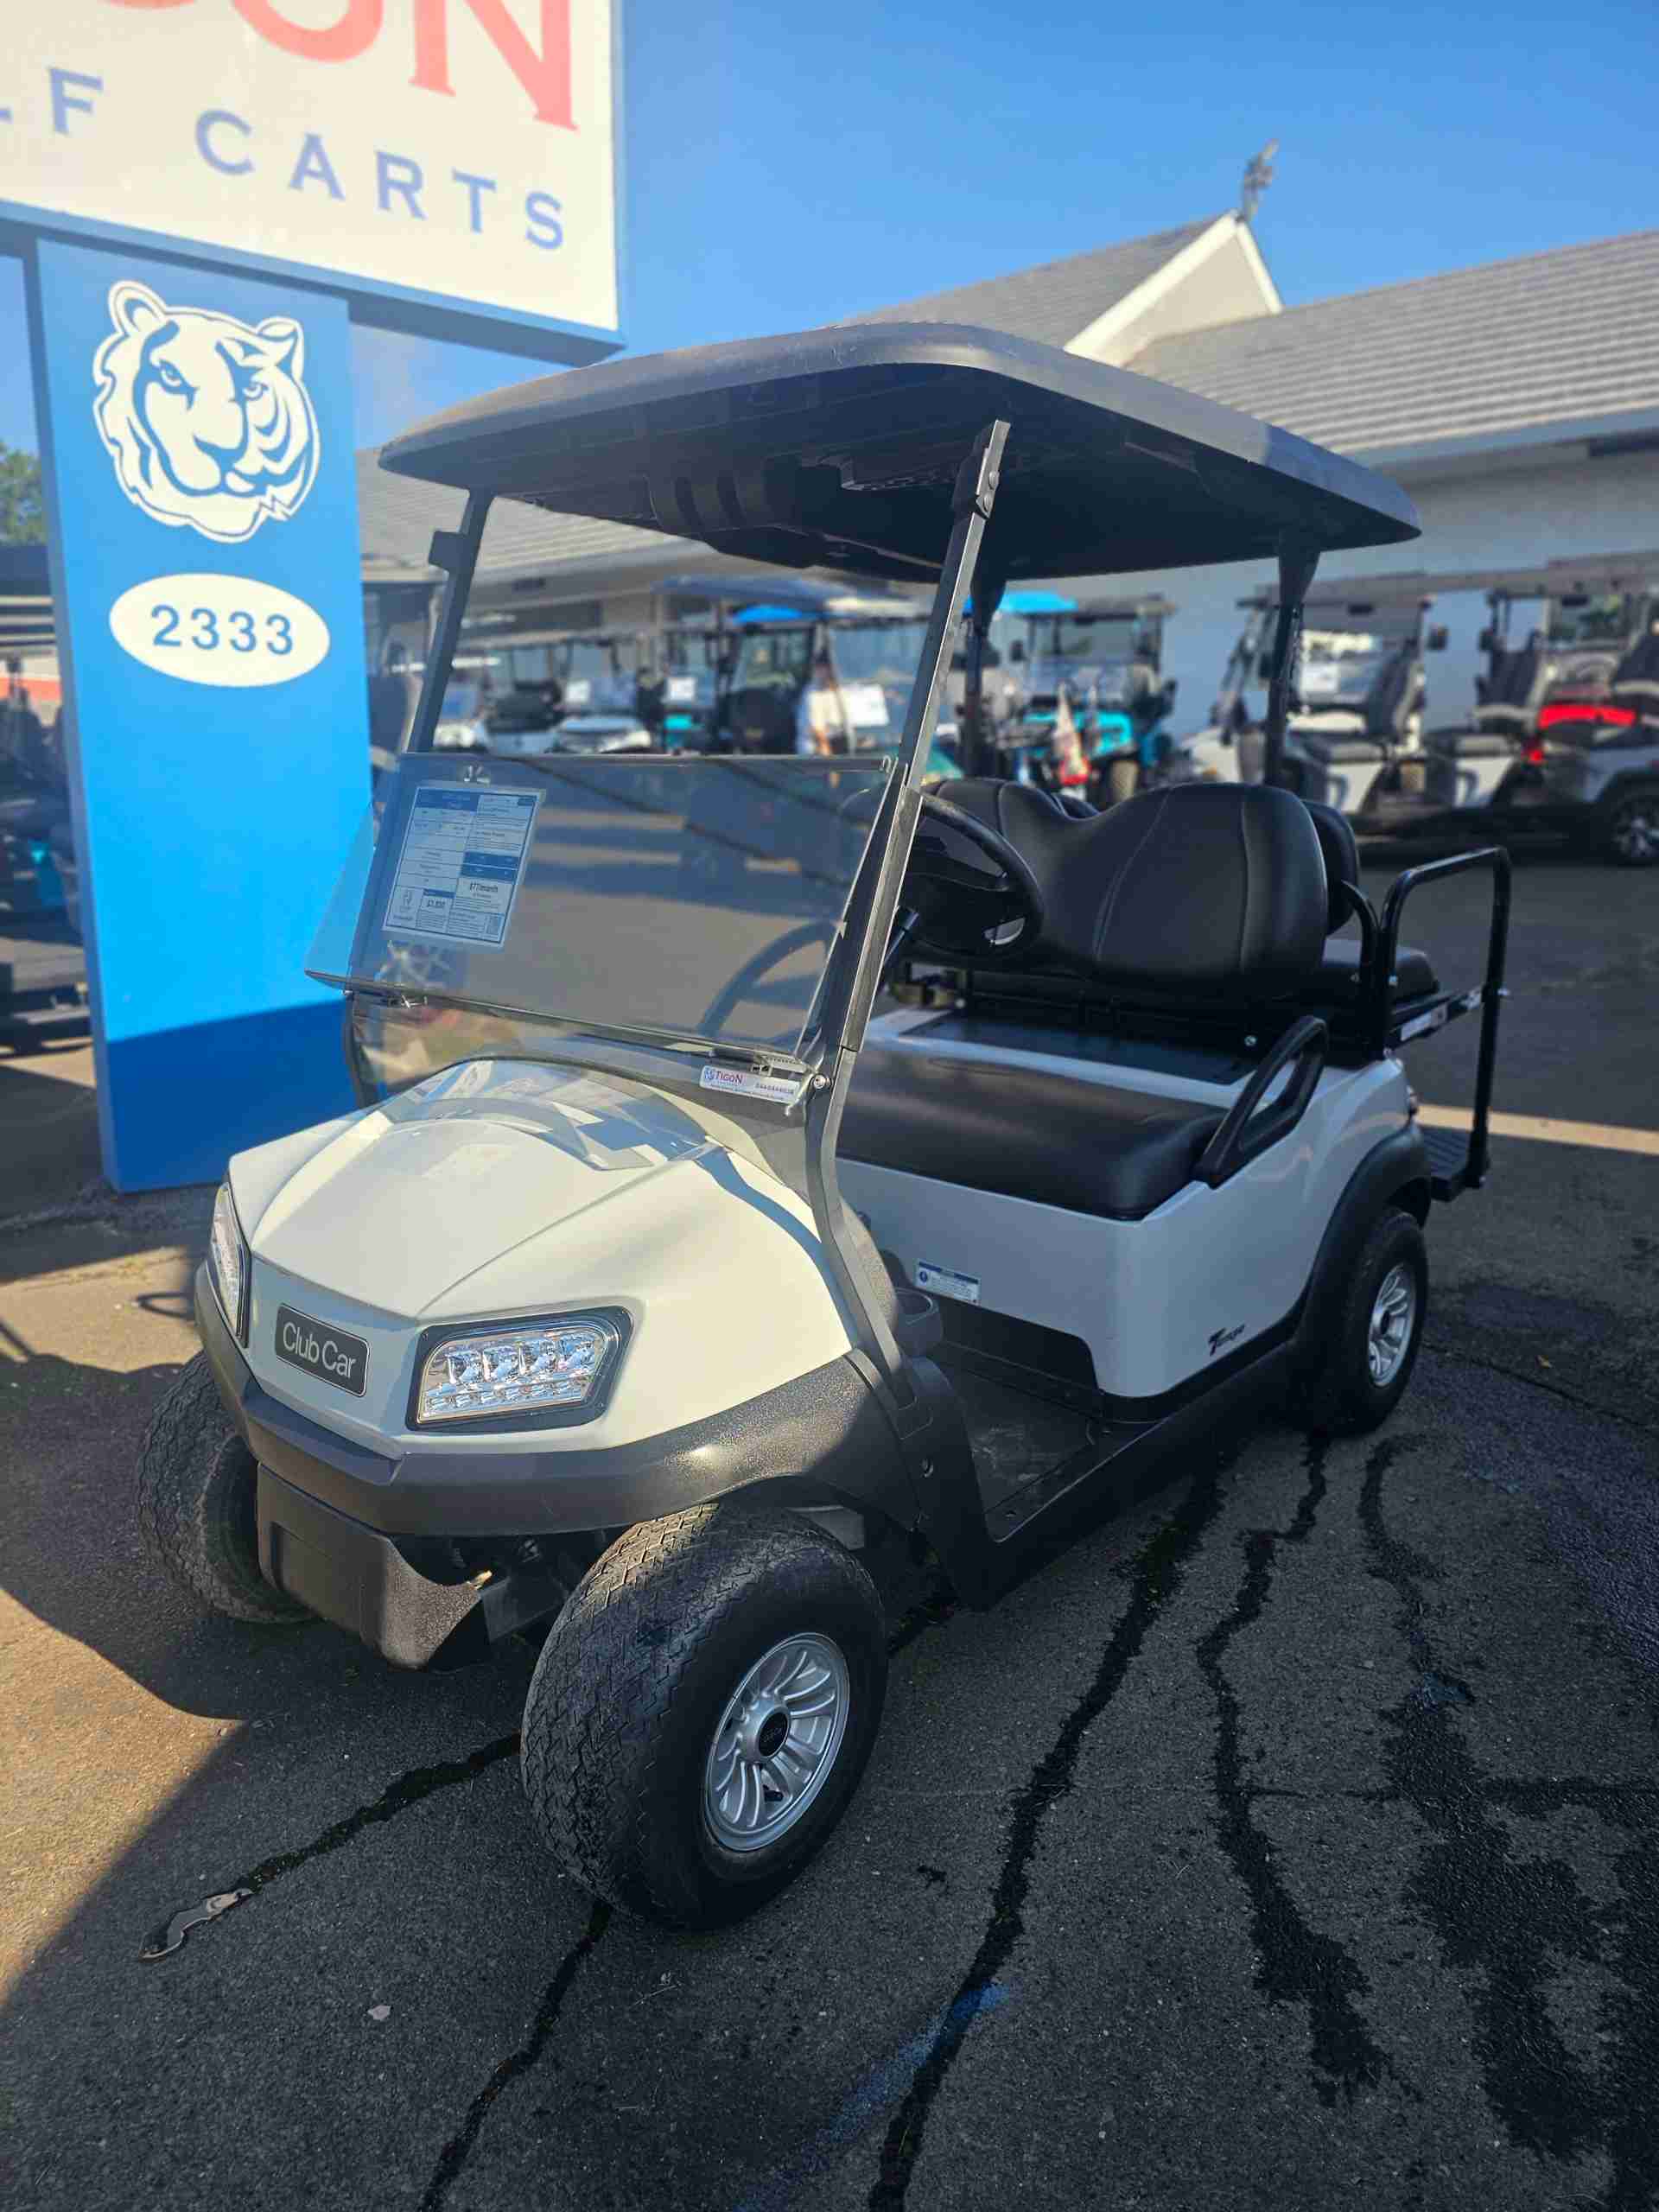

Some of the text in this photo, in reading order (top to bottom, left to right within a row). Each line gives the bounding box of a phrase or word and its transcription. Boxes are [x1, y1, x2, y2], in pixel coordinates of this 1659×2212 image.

[195, 109, 563, 251] CARTS
[151, 604, 293, 655] 2333
[283, 1321, 357, 1378] Club Car
